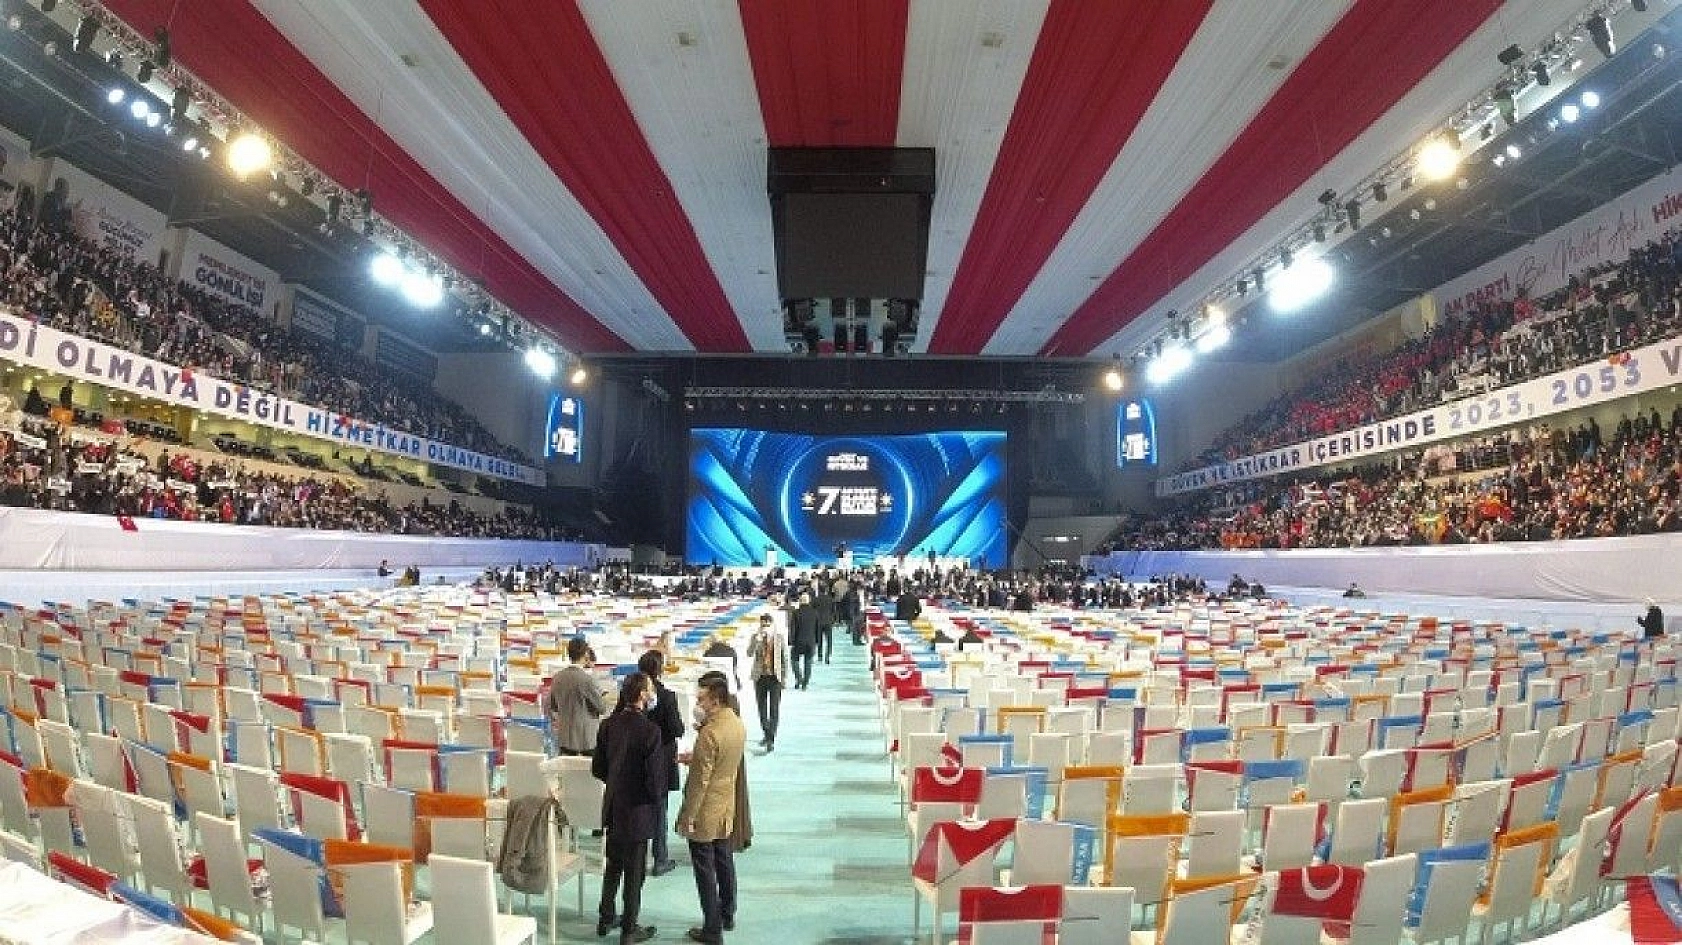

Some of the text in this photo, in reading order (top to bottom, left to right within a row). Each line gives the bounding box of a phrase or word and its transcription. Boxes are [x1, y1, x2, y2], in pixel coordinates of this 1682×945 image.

[57, 340, 198, 402] OLMAYA
[215, 385, 296, 426] DEĞİL
[428, 443, 483, 472] OLMAYA
[1308, 413, 1437, 463] İÇERİSİNDE
[1449, 390, 1535, 430] 2023,
[1551, 358, 1642, 406] 2053
